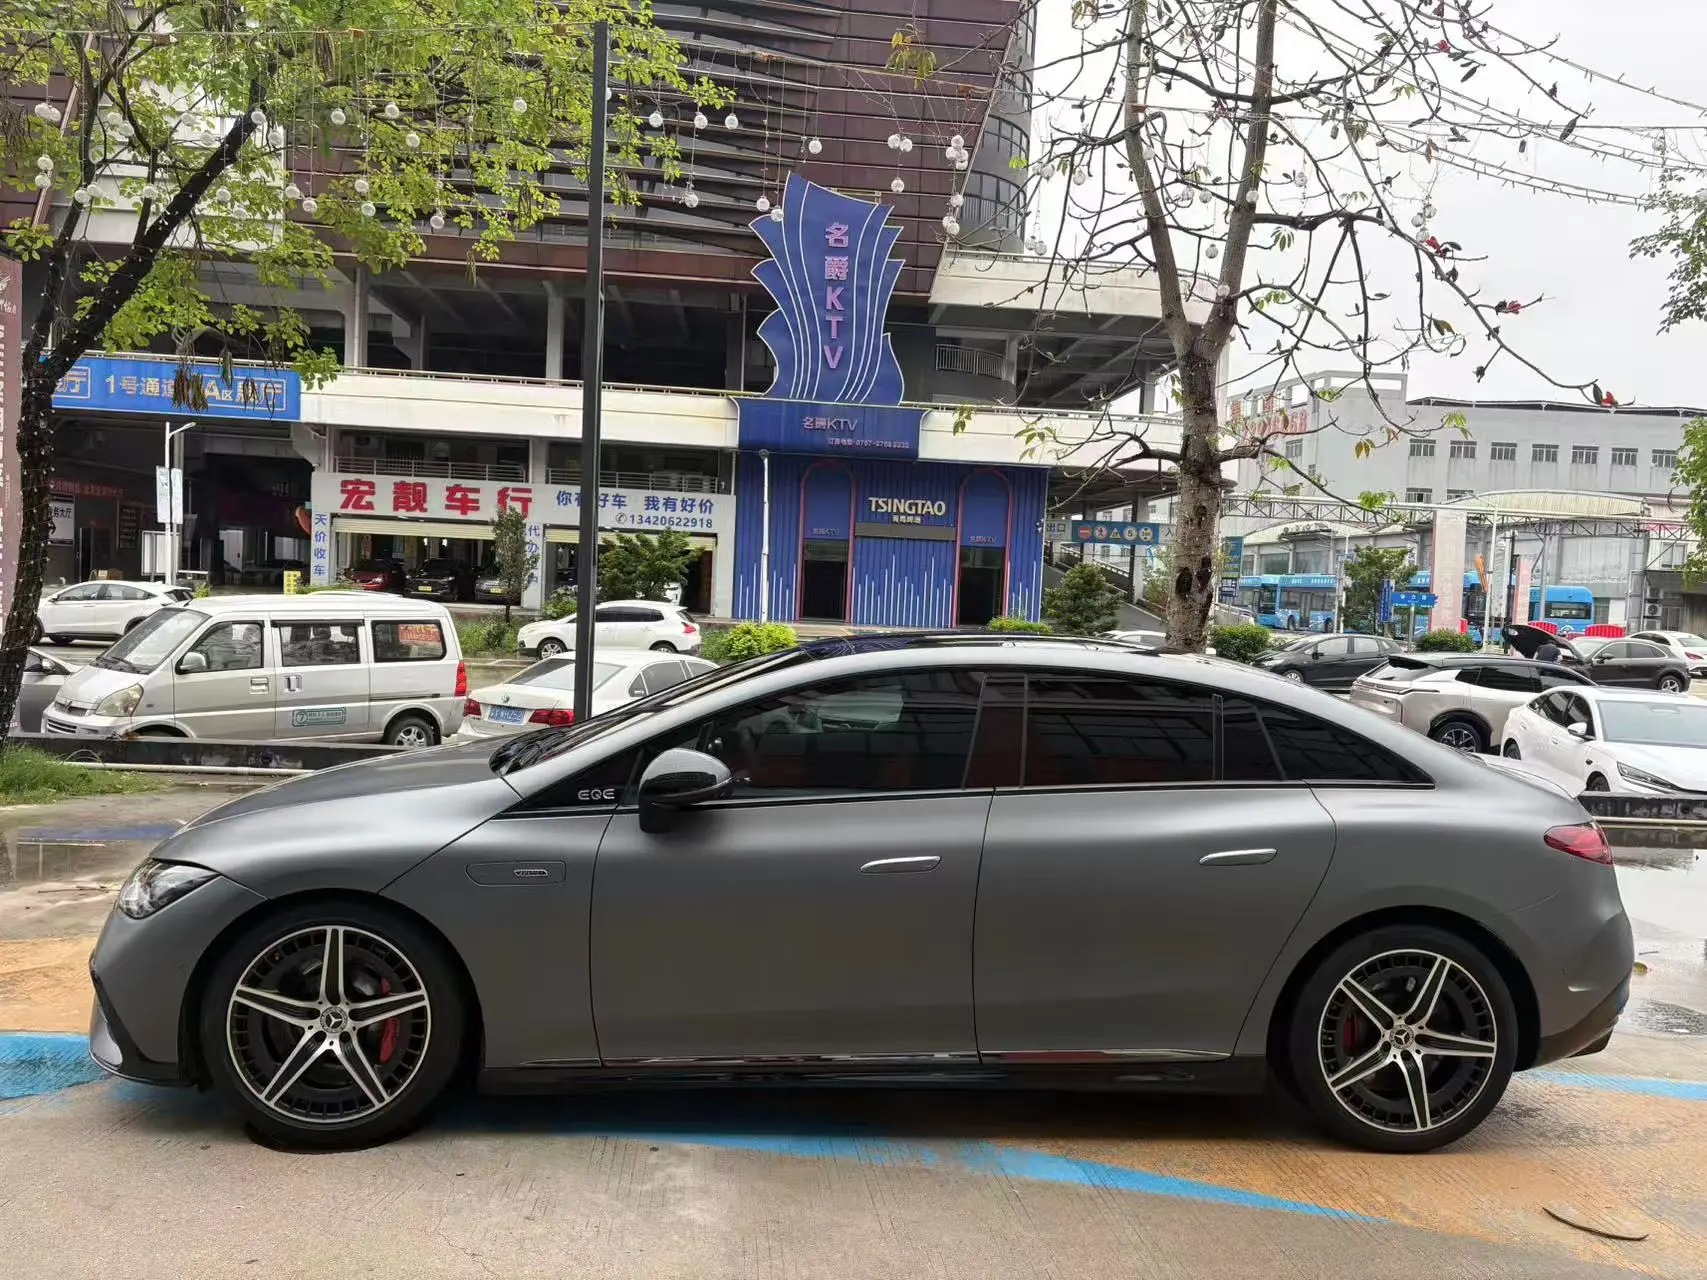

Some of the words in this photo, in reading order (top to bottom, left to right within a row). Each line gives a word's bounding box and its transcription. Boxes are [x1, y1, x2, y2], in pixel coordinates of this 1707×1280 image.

[824, 221, 849, 370] 名爵KTV
[339, 478, 534, 520] 宏靓车行
[644, 495, 715, 514] 我有好价
[868, 497, 946, 516] TSINGTAO
[51, 506, 72, 519] 务大厅
[629, 514, 713, 529] 13420622918
[313, 512, 327, 577] 天价收车
[527, 525, 541, 584] 代办户
[577, 787, 615, 800] EQE
